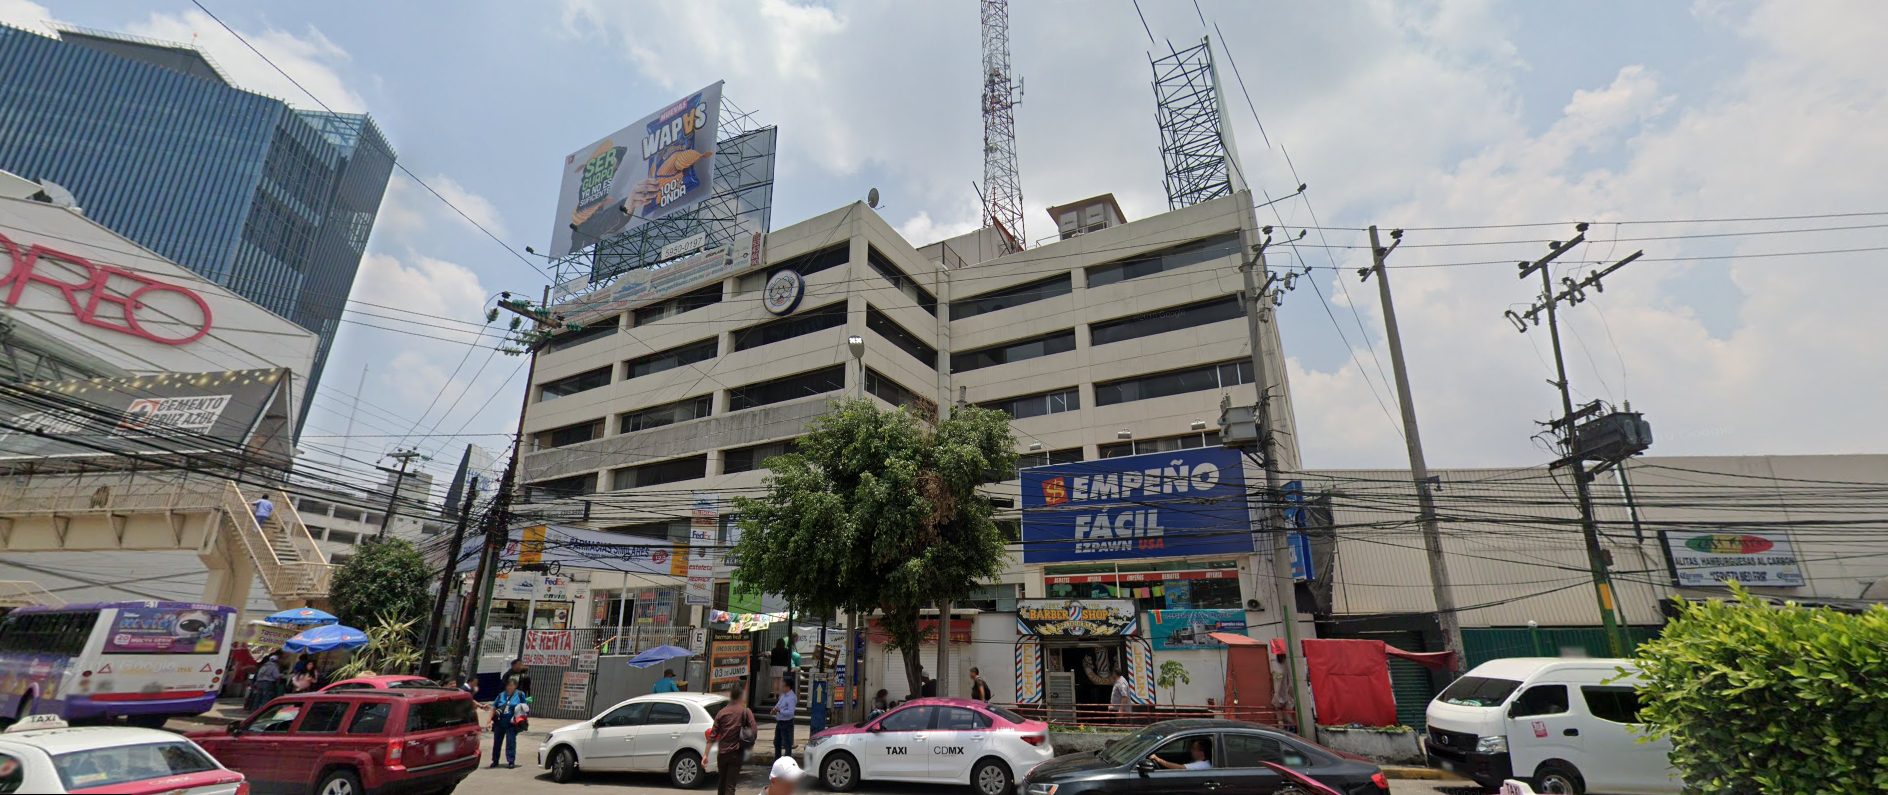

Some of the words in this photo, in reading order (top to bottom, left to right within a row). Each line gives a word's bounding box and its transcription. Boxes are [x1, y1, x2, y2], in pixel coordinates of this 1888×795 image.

[586, 149, 617, 176] SER
[582, 167, 614, 190] GUAPO
[591, 185, 602, 195] NO
[603, 178, 613, 190] ES
[660, 185, 686, 208] ONDA
[0, 232, 213, 346] REO
[158, 397, 223, 412] CEMENTO
[151, 413, 183, 427] CRUZ
[182, 411, 215, 425] AZUL
[1072, 458, 1220, 502] EMPEÑO
[1074, 508, 1165, 541] FÁCIL
[1074, 540, 1132, 554] EZPAWN
[1138, 537, 1165, 550] USA
[544, 577, 566, 586] FedEx
[1029, 609, 1069, 620] BARBER
[1081, 609, 1110, 620] SHOP
[525, 630, 537, 650] SE
[539, 630, 572, 651] RENTA
[696, 633, 702, 643] E
[714, 669, 723, 678] 03
[729, 666, 746, 675] JUNIO
[1023, 644, 1033, 696] FELIX
[886, 746, 907, 755] TAXI
[934, 746, 965, 755] CDMX
